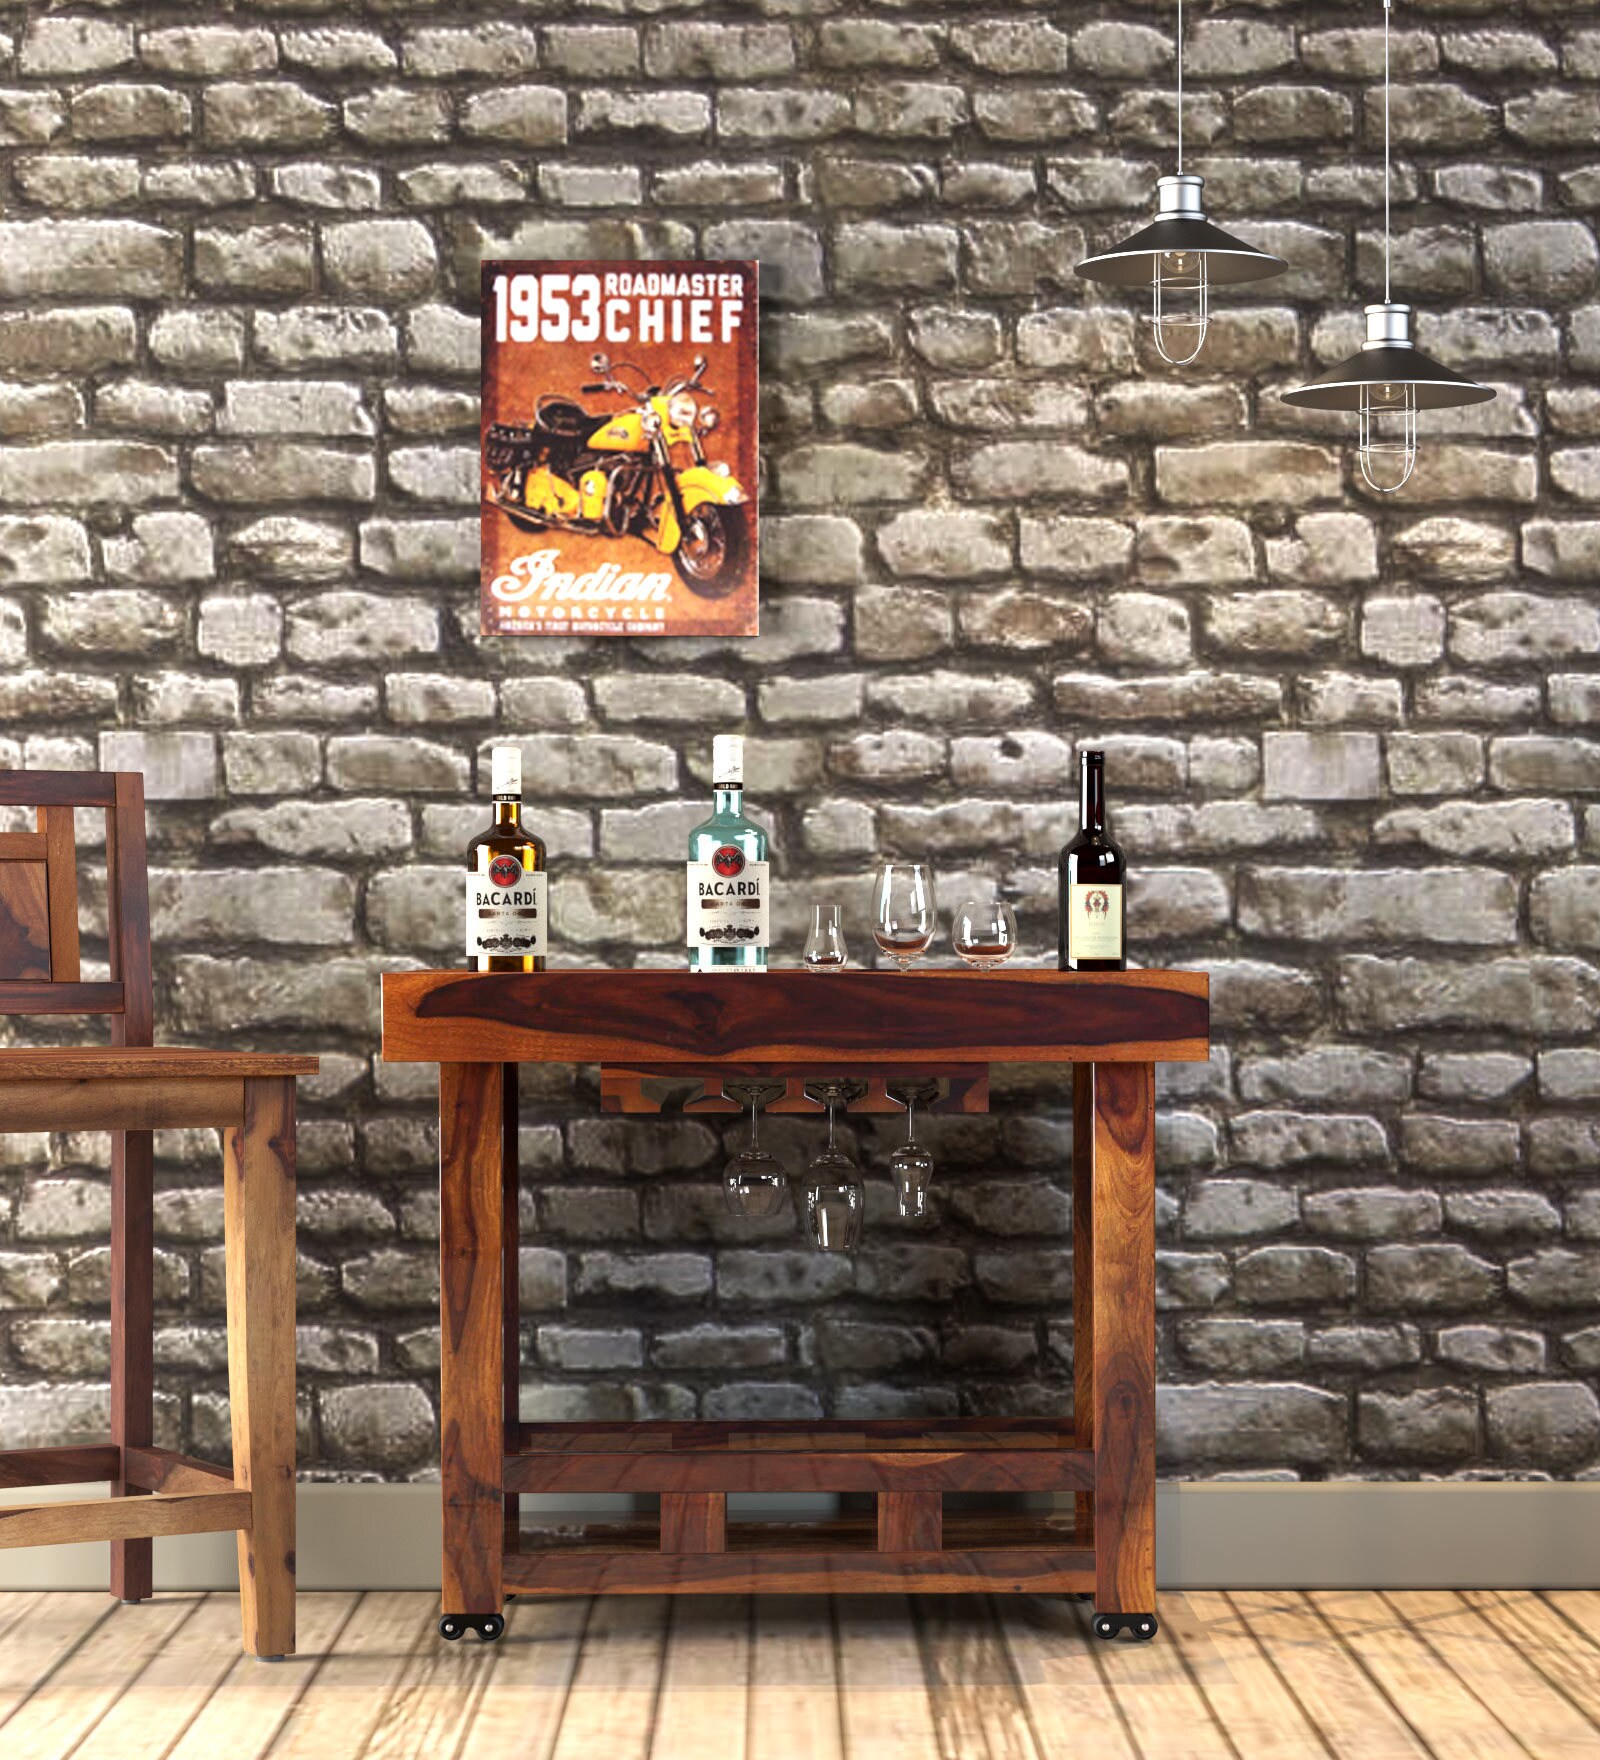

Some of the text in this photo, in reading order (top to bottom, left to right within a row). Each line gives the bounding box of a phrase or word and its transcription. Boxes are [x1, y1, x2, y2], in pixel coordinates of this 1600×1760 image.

[605, 273, 744, 297] ROADMASTER
[493, 274, 600, 342] 1953
[605, 299, 744, 343] CHIEF
[491, 549, 672, 602] Indian
[499, 606, 665, 619] MOTORCYCLE
[476, 887, 537, 906] BACARDÍ
[698, 877, 760, 896] BACARDÍ
